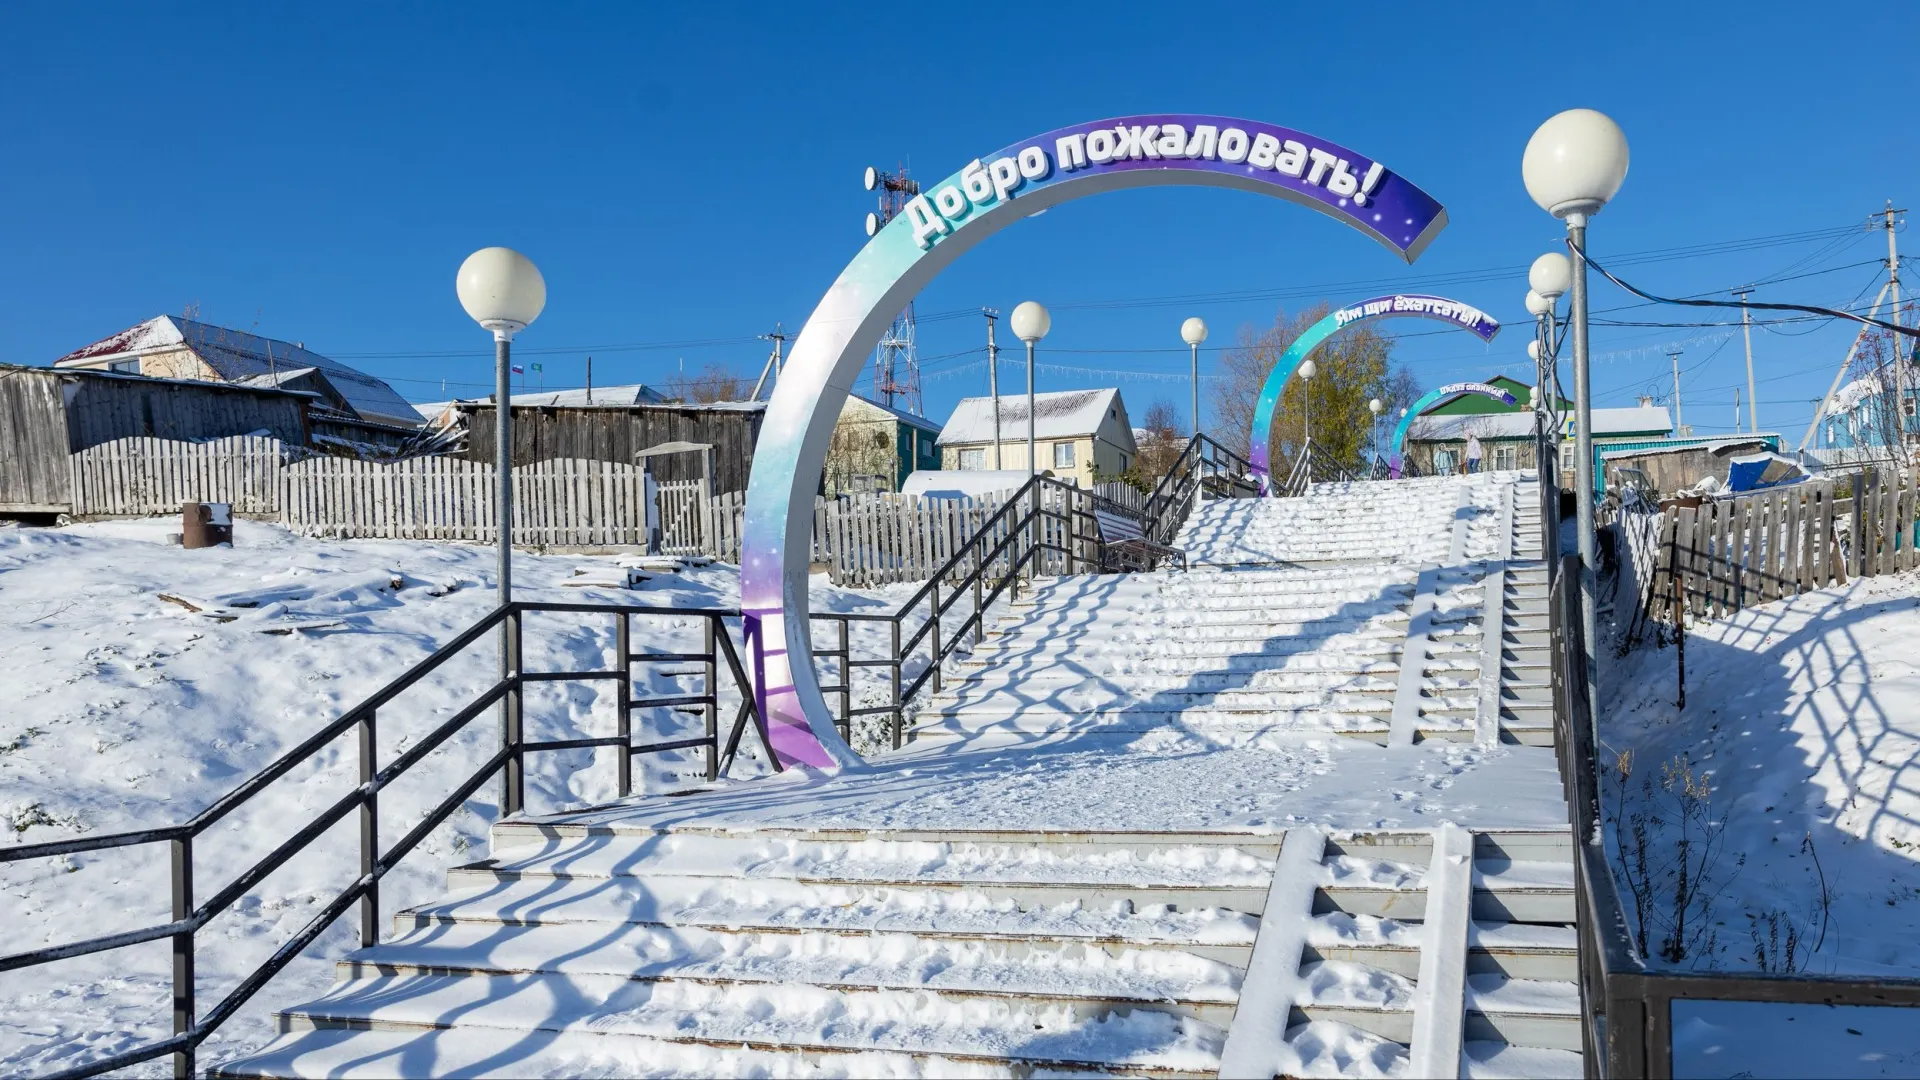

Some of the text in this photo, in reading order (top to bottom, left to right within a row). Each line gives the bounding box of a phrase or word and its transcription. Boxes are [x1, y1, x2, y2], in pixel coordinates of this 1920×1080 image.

[904, 124, 1385, 249] Добро пожаловать!
[1334, 307, 1363, 327] Ям
[1364, 299, 1393, 315] щи
